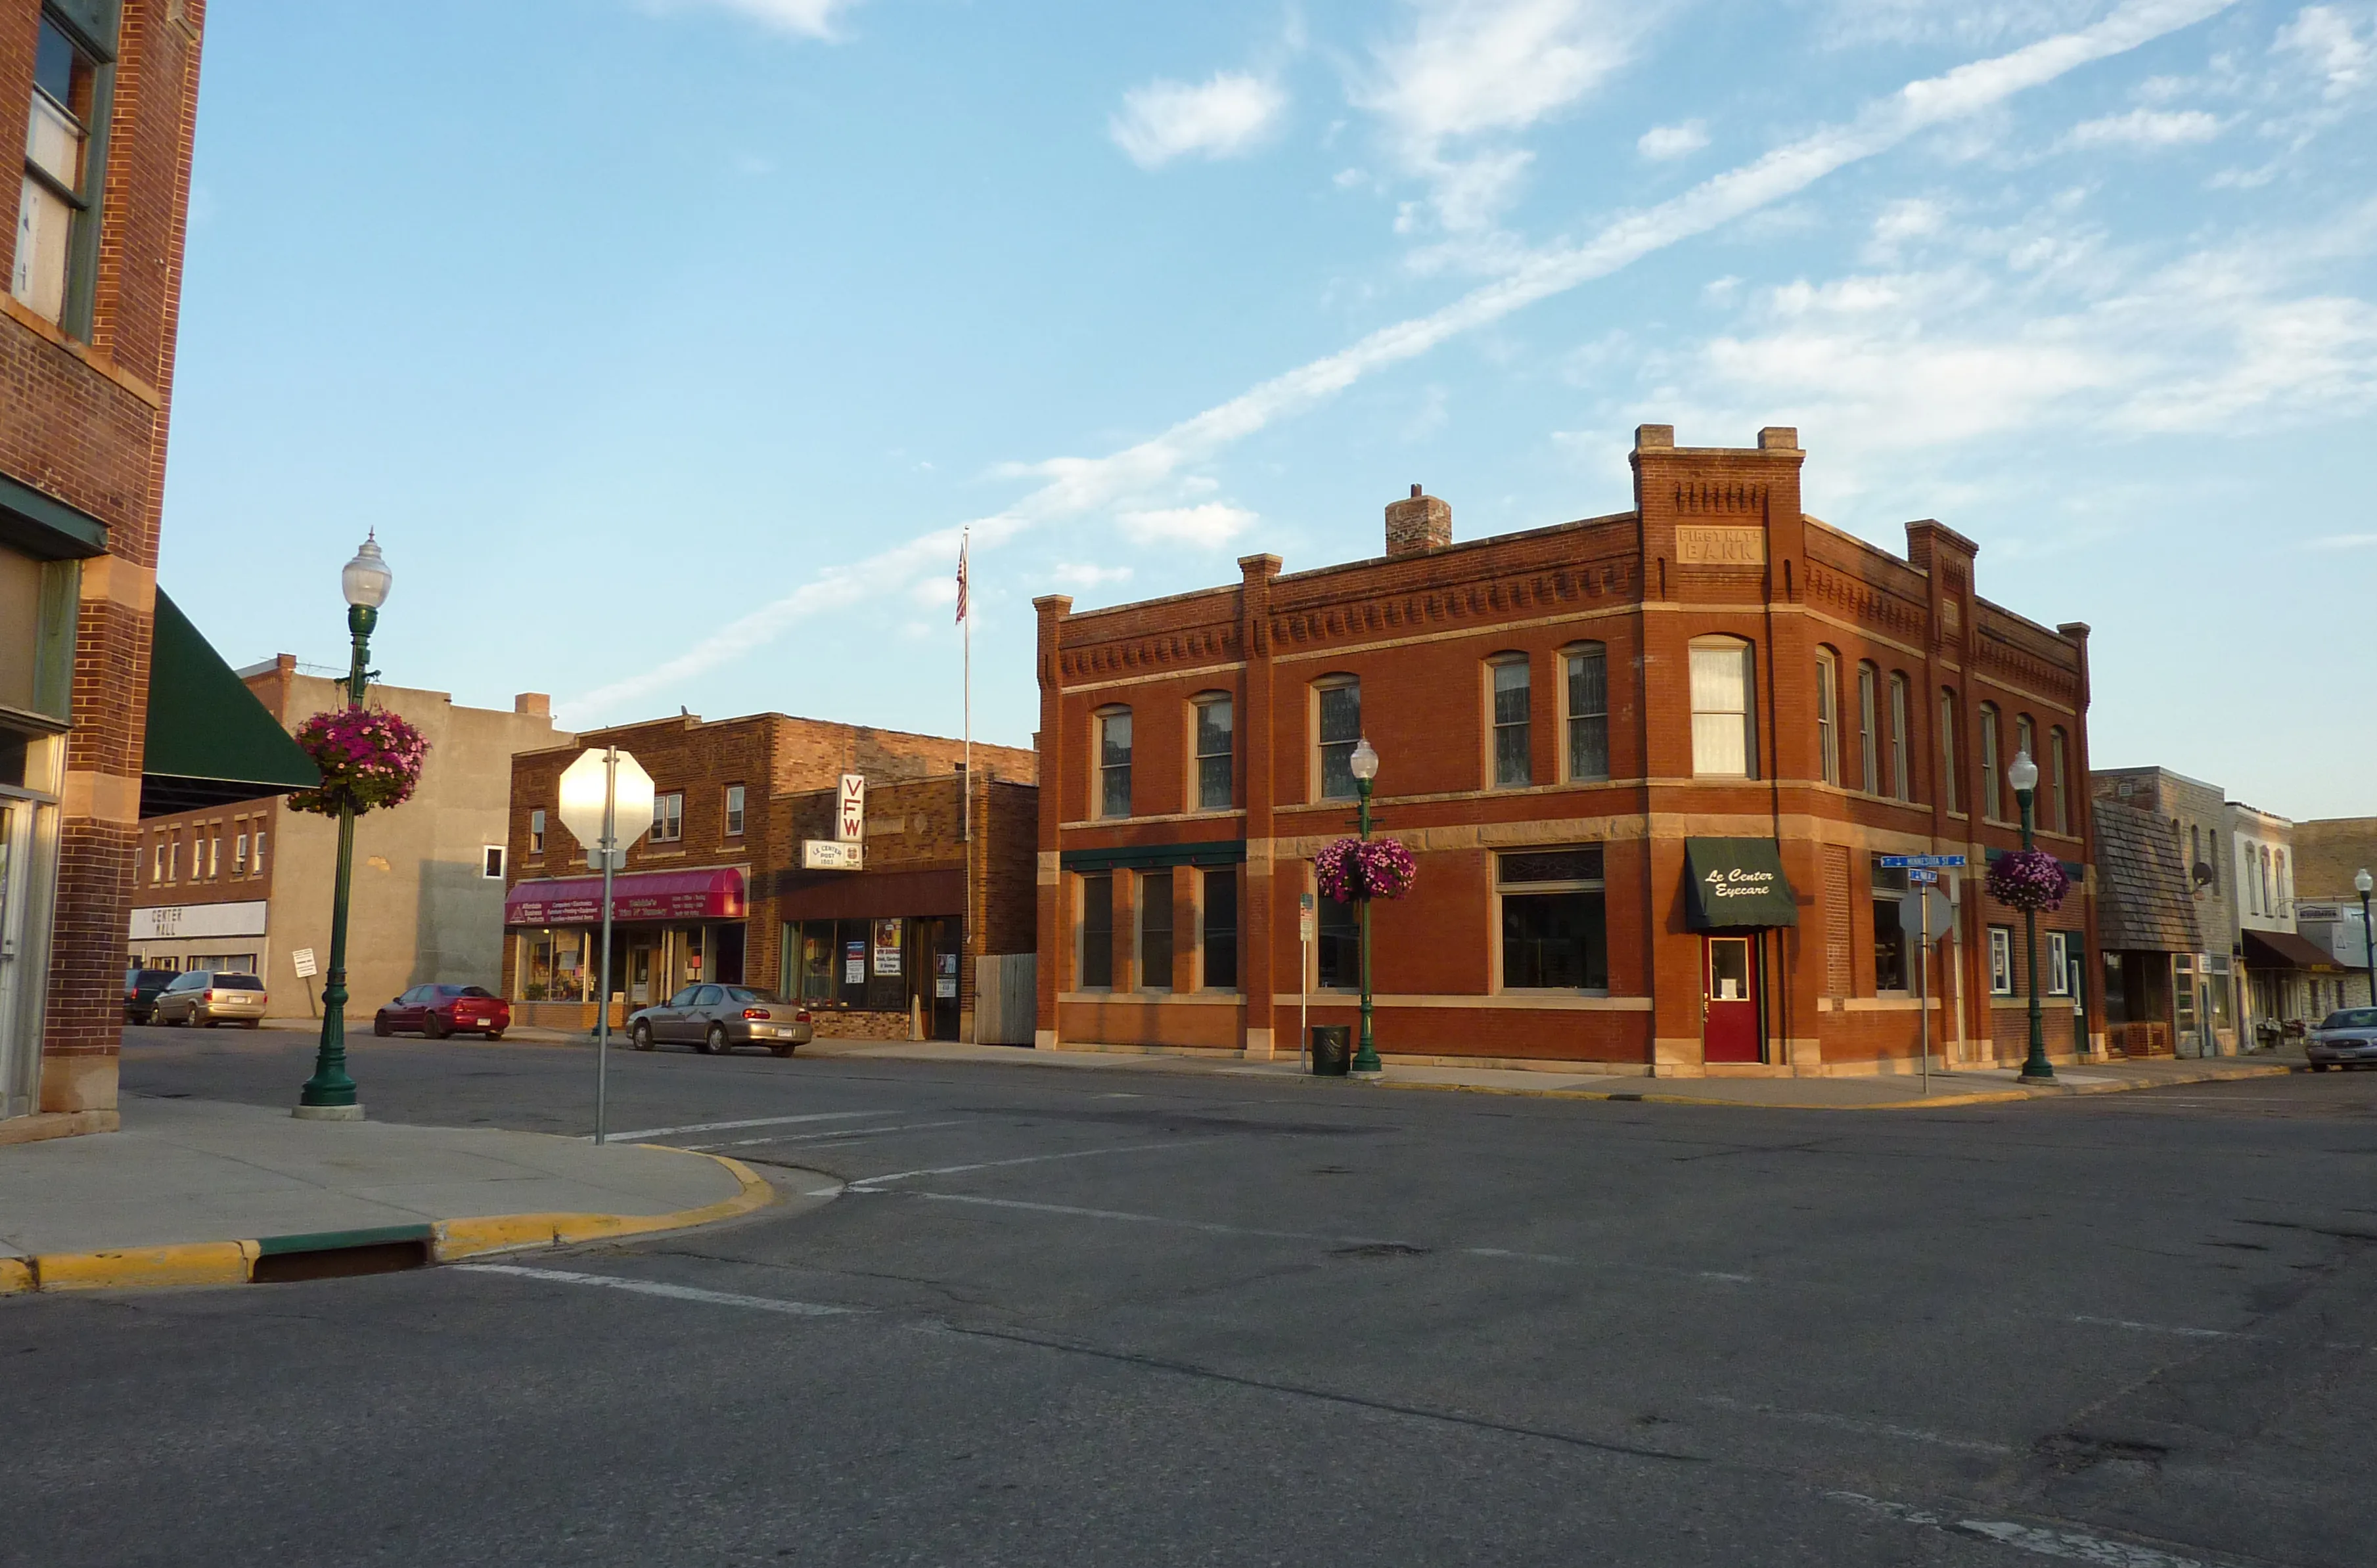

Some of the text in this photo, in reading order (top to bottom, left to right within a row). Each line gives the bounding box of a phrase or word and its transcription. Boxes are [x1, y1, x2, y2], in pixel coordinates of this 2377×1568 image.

[1679, 530, 1722, 543] FIRST
[1686, 543, 1755, 560] BANK
[844, 779, 862, 836] VFW
[821, 845, 842, 857] CENTER
[1907, 857, 1949, 866] MINNESOTA ST
[1704, 868, 1774, 882] Le Center
[1715, 883, 1770, 897] Eyecare
[152, 908, 182, 923] CENTER
